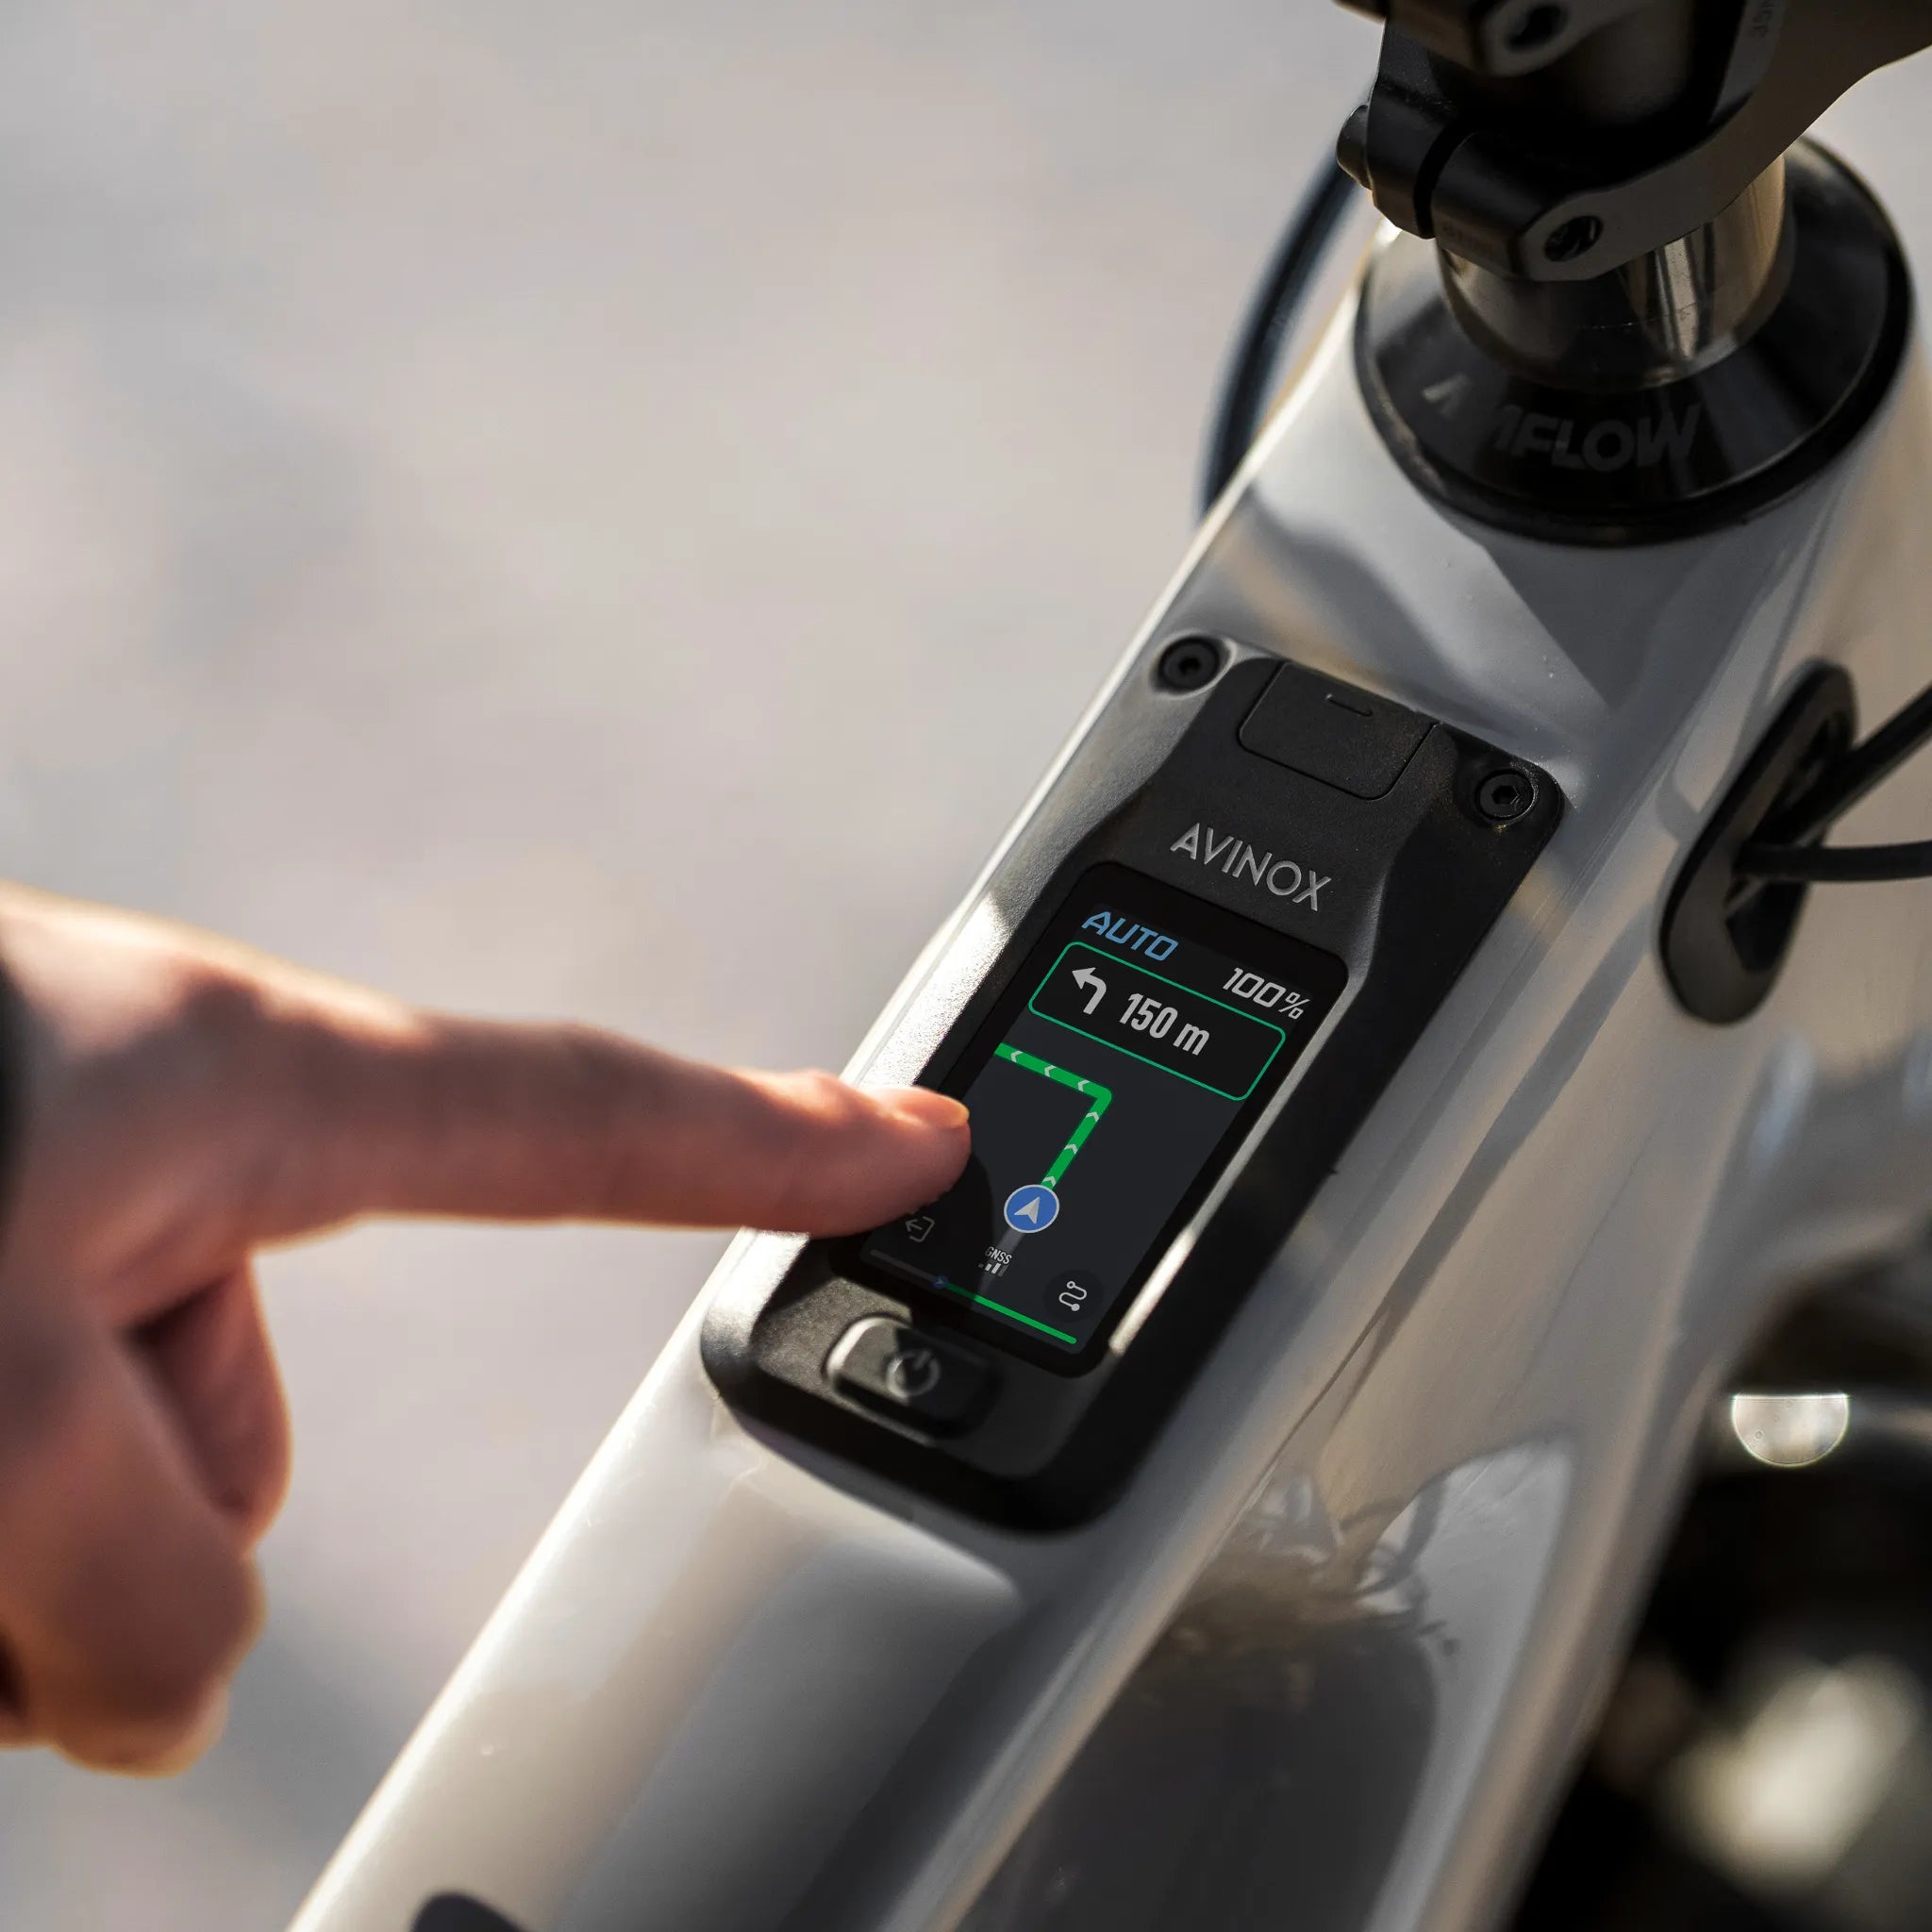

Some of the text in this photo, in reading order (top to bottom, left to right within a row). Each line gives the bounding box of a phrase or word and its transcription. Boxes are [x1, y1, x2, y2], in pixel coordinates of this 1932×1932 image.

[1169, 822, 1332, 912] AVINOX
[1081, 910, 1179, 961] AUTO
[1223, 967, 1310, 1020] 100%
[1119, 992, 1210, 1056] 150 m
[984, 1246, 1012, 1264] GNSS
